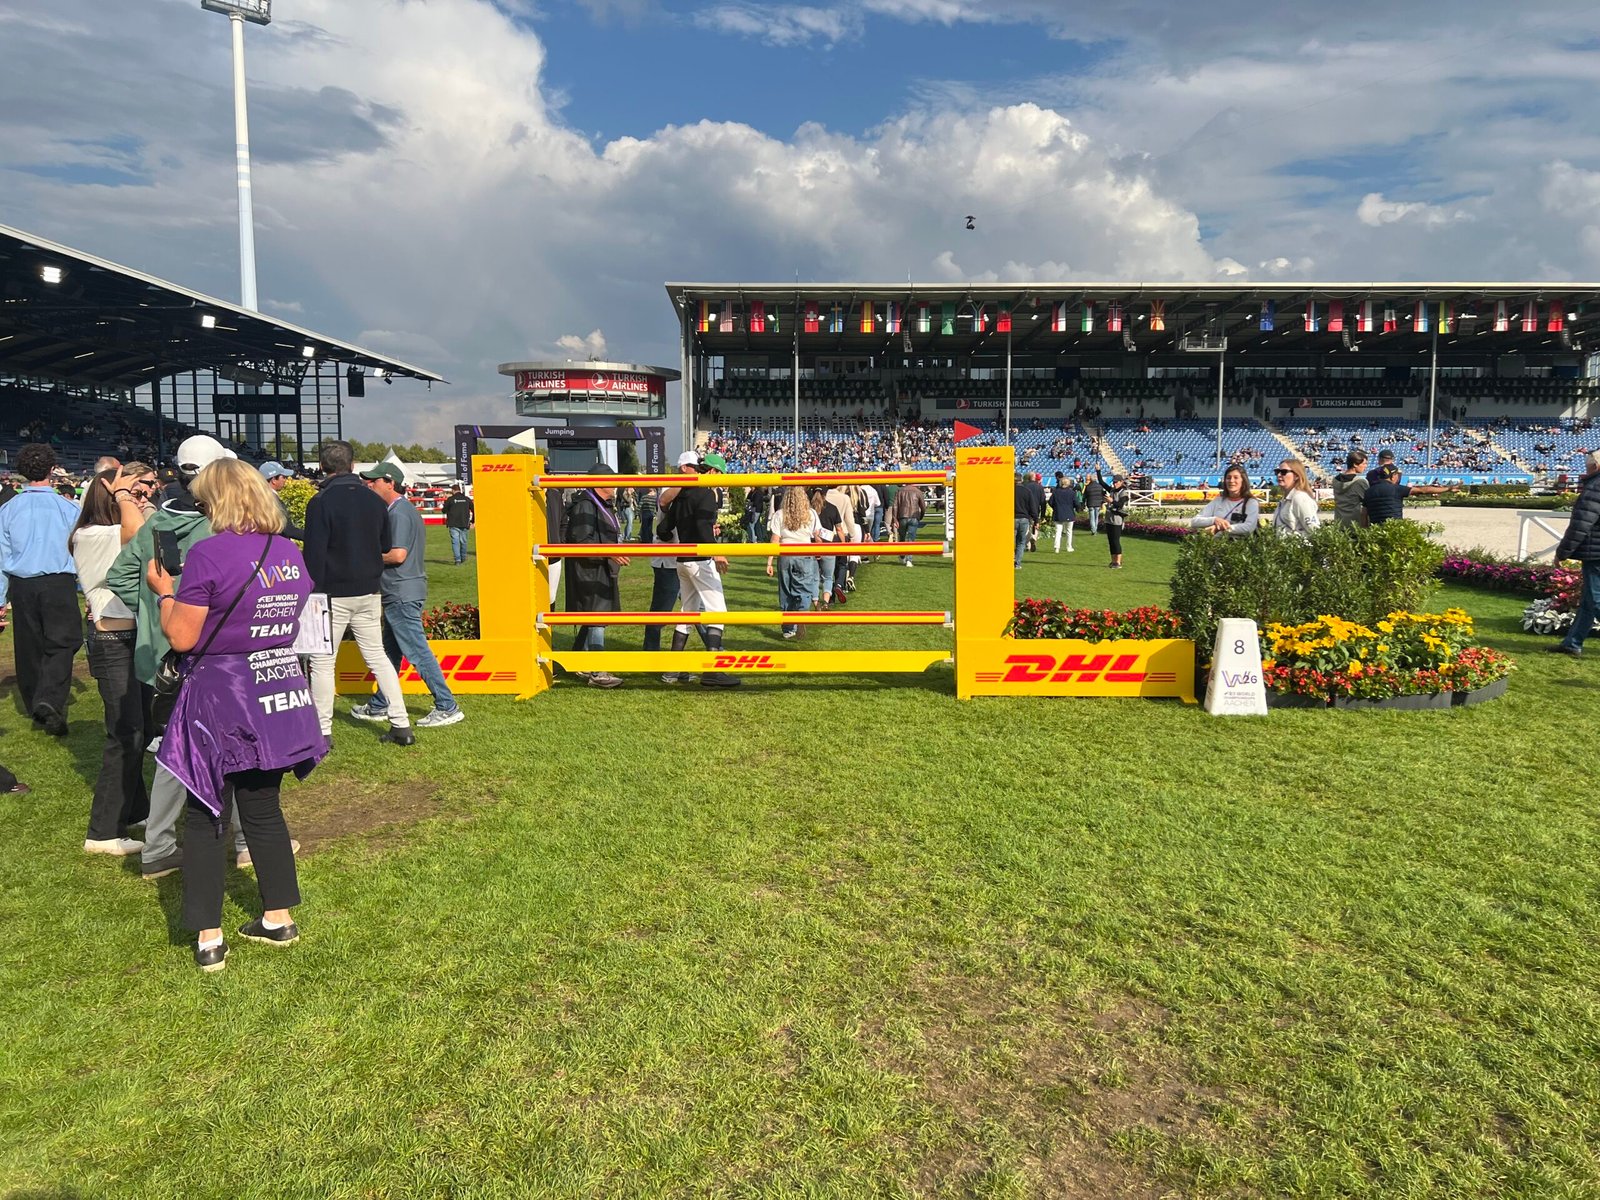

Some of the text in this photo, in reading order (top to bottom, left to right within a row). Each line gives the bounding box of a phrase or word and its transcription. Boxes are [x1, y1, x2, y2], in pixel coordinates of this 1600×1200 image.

[528, 371, 565, 380] TURKISH
[612, 373, 648, 383] TURKISH
[528, 380, 566, 388] AIRLINES
[612, 382, 648, 391] AIRLINES
[545, 427, 575, 436] Jumping
[967, 456, 1004, 465] DHL
[461, 463, 468, 472] of
[481, 464, 515, 472] DHL
[652, 465, 659, 473] of
[275, 594, 299, 602] WORLD
[253, 607, 296, 619] AACHEN
[250, 622, 294, 638] TEAM
[1234, 639, 1245, 655] 8
[714, 655, 775, 669] DHL
[1002, 654, 1149, 682] DHL
[255, 663, 303, 685] AACHEN
[258, 688, 313, 715] TEAM
